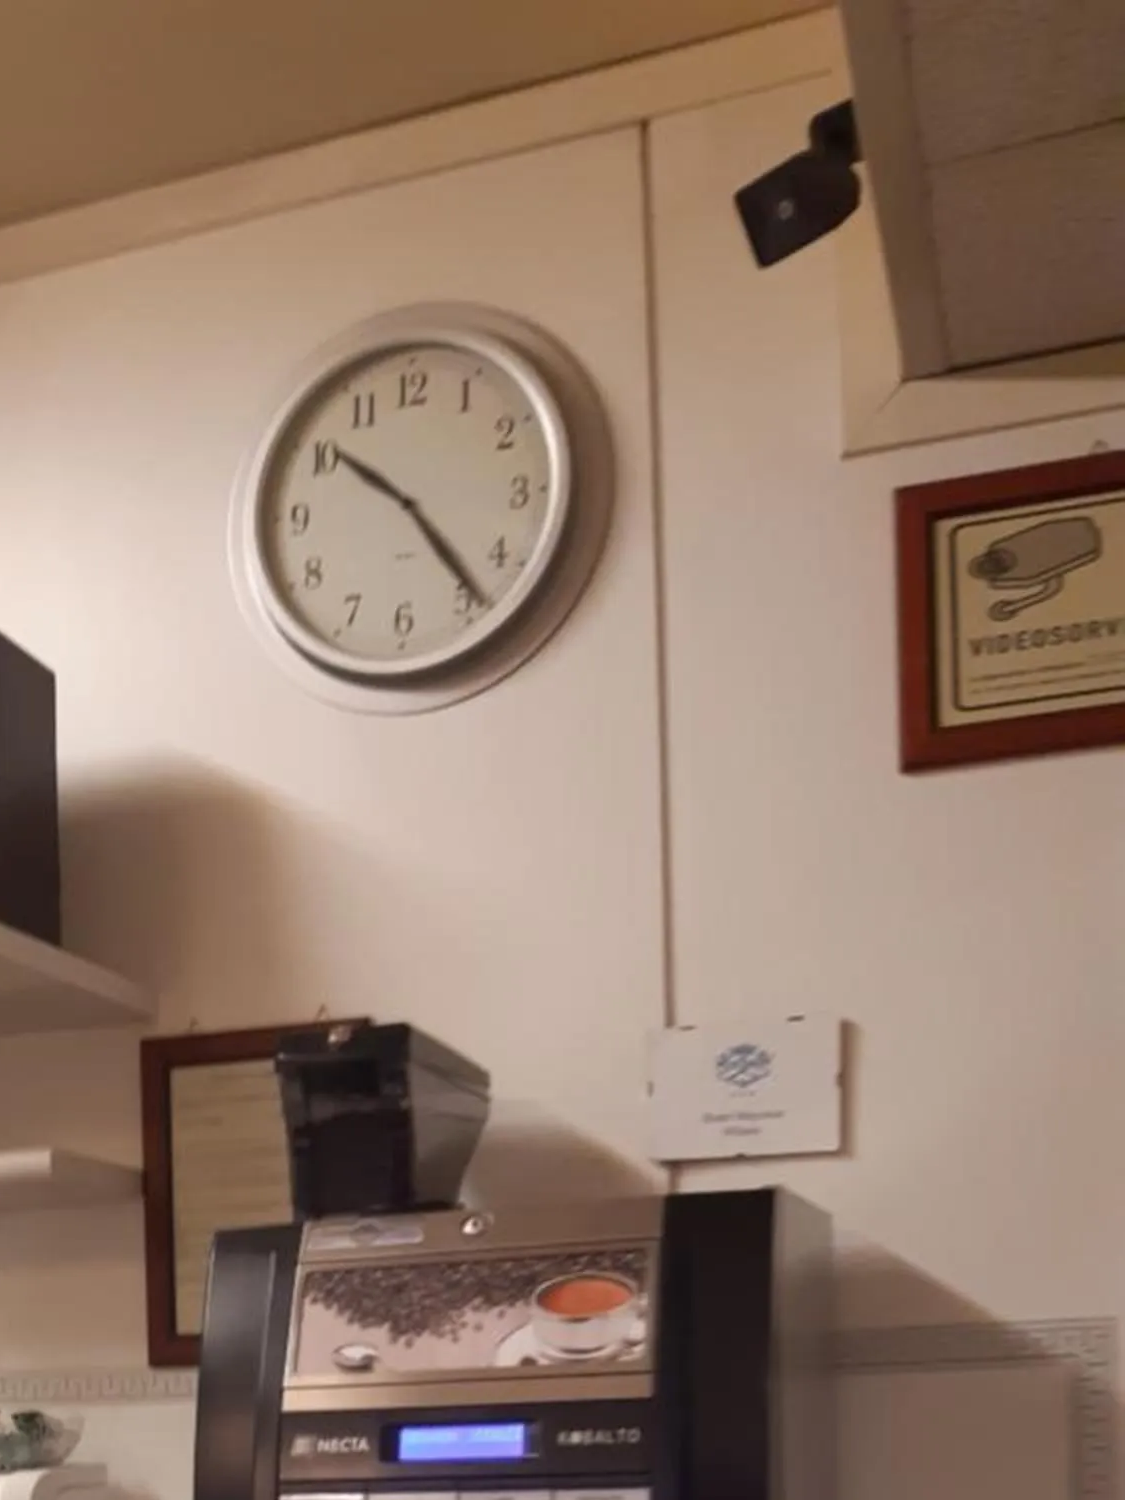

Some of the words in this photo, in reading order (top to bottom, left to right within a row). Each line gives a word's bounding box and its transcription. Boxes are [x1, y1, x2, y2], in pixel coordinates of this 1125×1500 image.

[396, 371, 428, 408] 12
[458, 379, 472, 413] 1
[351, 393, 376, 429] 11
[494, 415, 517, 451] 2
[312, 440, 339, 477] 10
[510, 475, 530, 510] 3
[291, 504, 310, 536] 9
[487, 537, 510, 568] 4
[304, 559, 323, 590] 8
[344, 593, 362, 627] 7
[394, 602, 415, 637] 6
[316, 1436, 371, 1454] NECTA
